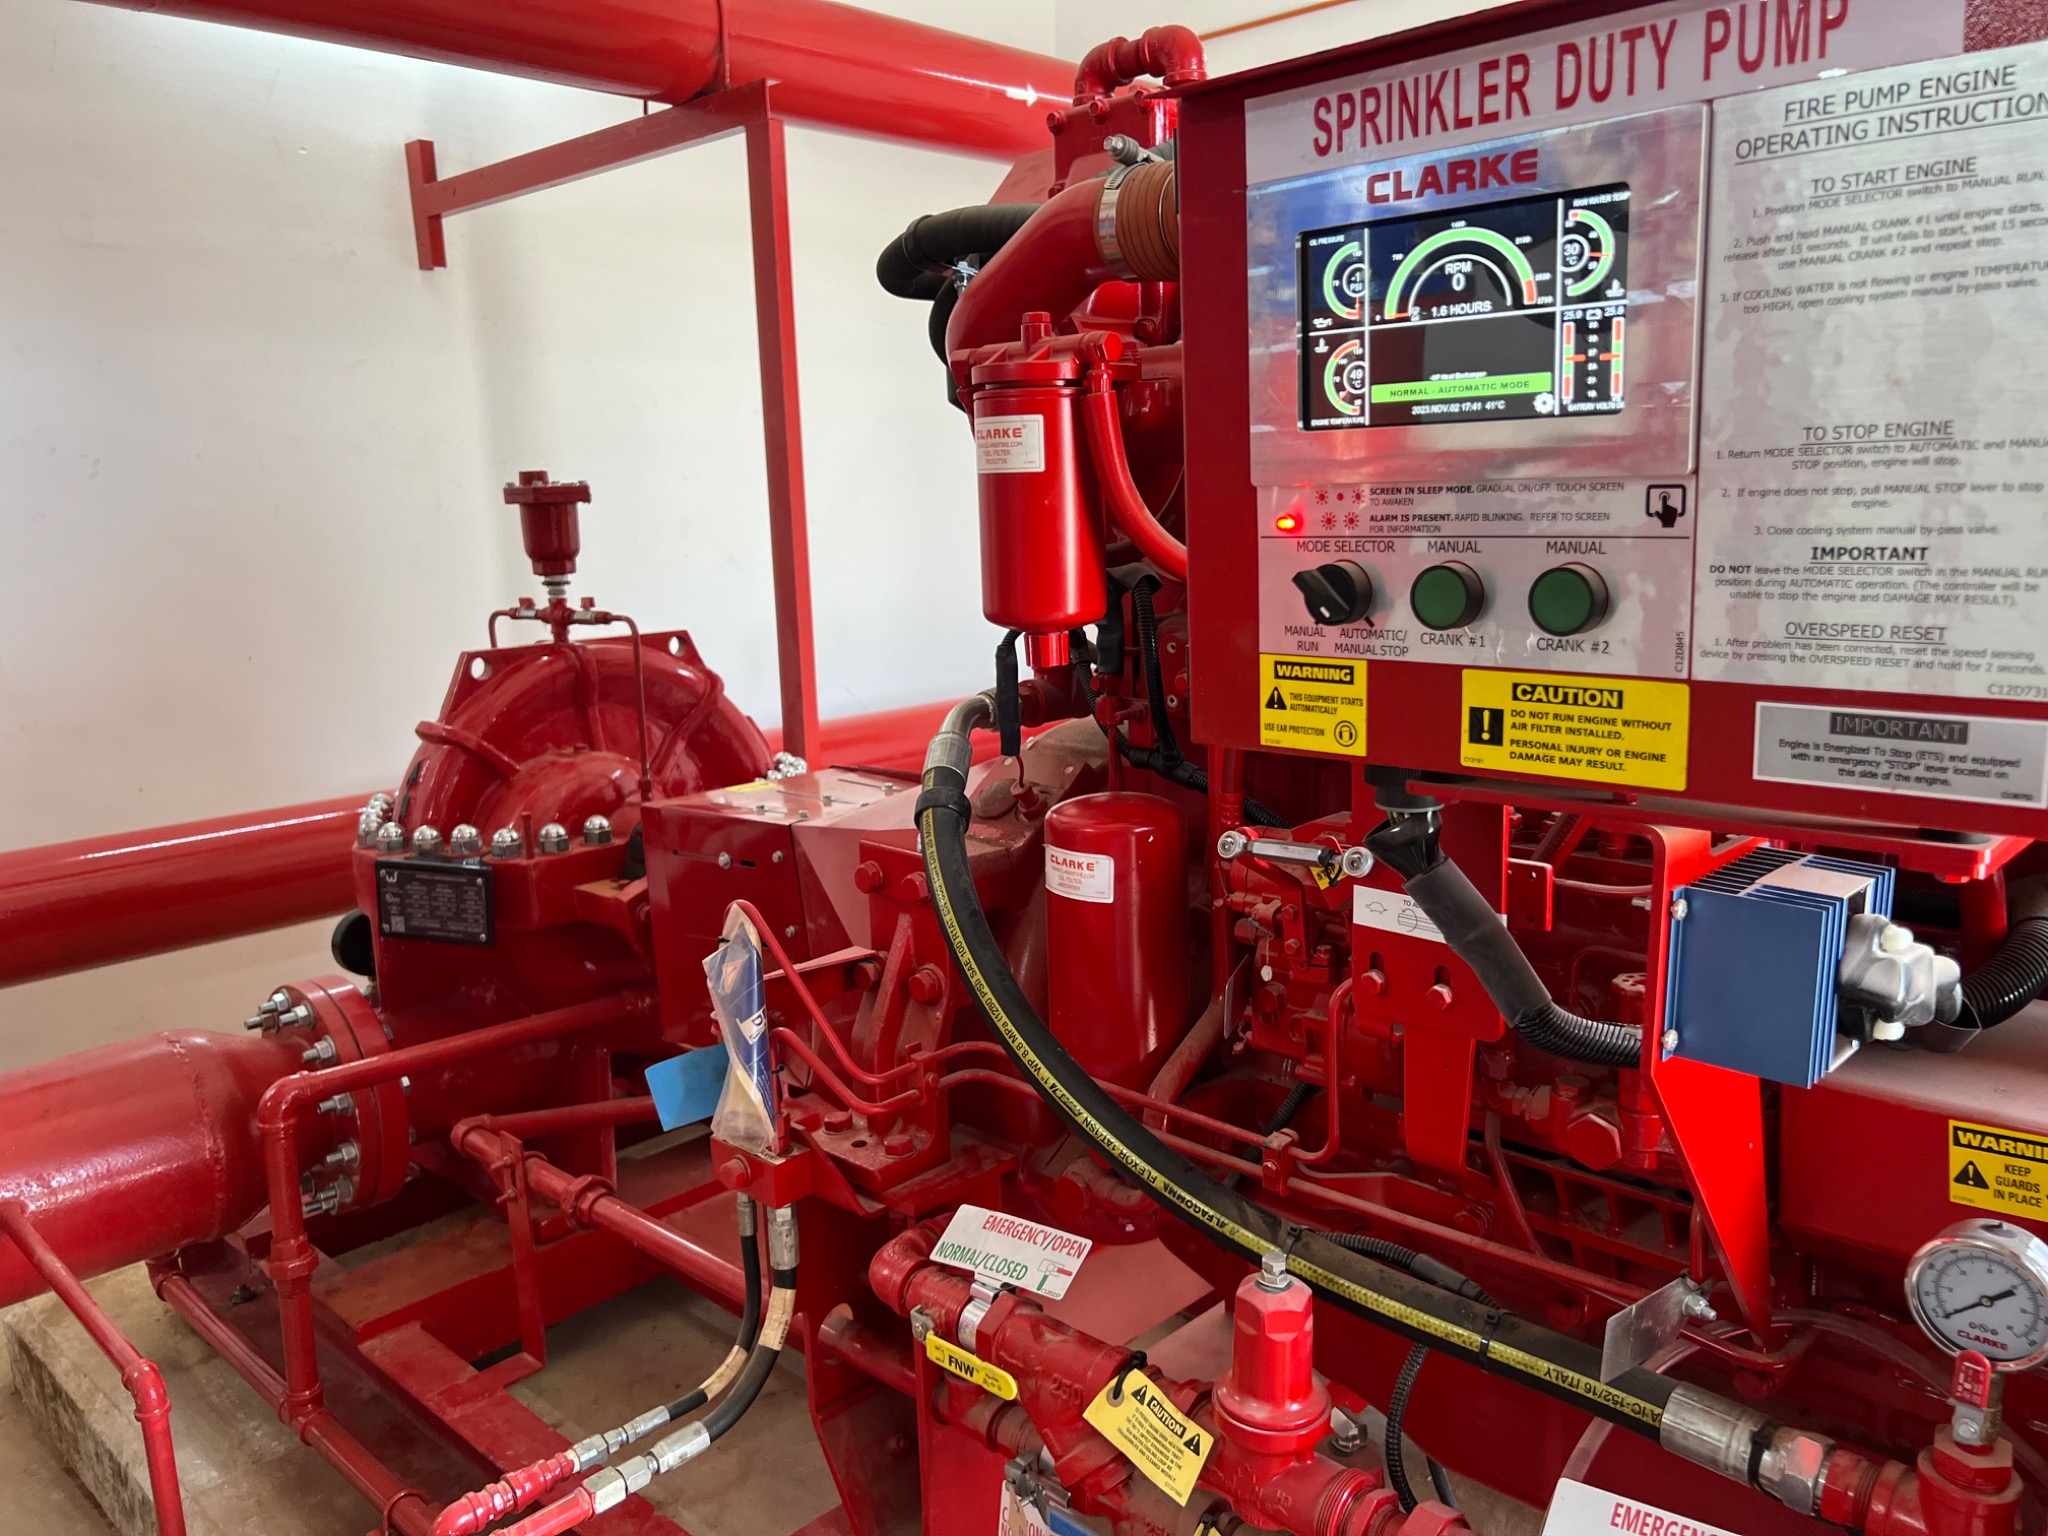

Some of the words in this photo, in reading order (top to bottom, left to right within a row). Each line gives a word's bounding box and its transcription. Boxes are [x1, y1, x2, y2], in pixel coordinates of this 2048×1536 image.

[1312, 52, 1531, 157] SPRINKLER
[1556, 18, 1678, 110] DUTY
[1702, 0, 1850, 81] PUMP
[1784, 94, 1836, 122] FIRE
[1845, 82, 1911, 112] PUMP
[1920, 64, 2016, 99] ENGINE
[1735, 120, 1868, 159] OPERATING
[1366, 149, 1539, 205] CLARKE
[1811, 176, 1835, 194] TO
[1841, 168, 1899, 190] START
[1905, 156, 1978, 181] ENGINE
[1589, 195, 1612, 205] WATER
[1764, 203, 1804, 217] Position
[1808, 198, 1840, 209] MODE
[1564, 243, 1580, 256] 30
[1445, 261, 1472, 275] RPM
[1452, 273, 1465, 291] 0
[1743, 286, 1792, 301] COOLING
[1431, 305, 1447, 318] 1.6
[1450, 301, 1492, 315] HOURS
[1350, 369, 1363, 380] 49
[1390, 388, 1430, 398] NORMAL
[1437, 383, 1497, 395] AUTOMATIC
[1500, 380, 1530, 390] MODE
[1462, 400, 1482, 411] 17:41
[1802, 426, 1827, 441] TO
[1832, 424, 1879, 441] STOP
[1885, 420, 1954, 438] ENGINE
[1728, 450, 1760, 459] Return
[1764, 447, 1794, 457] MODE
[1797, 446, 1852, 457] SELECTOR
[1791, 460, 1820, 470] STOP
[1369, 486, 1402, 496] SCREEN
[1405, 486, 1415, 495] IN
[1417, 486, 1444, 495] SLEEP
[1446, 485, 1475, 495] MODE.
[1475, 484, 1515, 493] GRADUAL
[1556, 482, 1586, 492] TOUCH
[1589, 482, 1624, 491] SCREEN
[1747, 488, 1781, 499] engine
[1784, 487, 1808, 496] does
[1369, 498, 1380, 506] TO
[1381, 497, 1414, 506] AWAKEN
[1369, 514, 1398, 523] ALARM
[1400, 514, 1410, 522] IS
[1412, 513, 1454, 522] PRESENT.
[1454, 513, 1479, 522] RAPID
[1482, 512, 1524, 522] BLINKING.
[1530, 512, 1557, 521] REFER
[1560, 512, 1572, 521] TO
[1575, 512, 1610, 521] SCREEN
[1369, 525, 1384, 533] FOR
[1386, 524, 1441, 533] INFORMATION
[1767, 526, 1793, 535] Close
[1296, 540, 1331, 553] MODE
[1334, 540, 1396, 553] SELECTOR
[1427, 541, 1481, 554] MANUAL
[1546, 541, 1606, 555] MANUAL
[1810, 547, 1929, 561] IMPORTANT
[1709, 565, 1725, 574] DO
[1728, 565, 1751, 574] NOT
[1754, 565, 1780, 575] leave
[1783, 565, 1799, 575] the
[1802, 566, 1834, 576] MODE
[1837, 566, 1893, 577] SELECTOR
[1715, 579, 1751, 588] position
[1755, 579, 1786, 589] during
[1788, 579, 1852, 589] AUTOMATIC
[1730, 590, 1761, 600] unable
[1778, 592, 1798, 601] stop
[1821, 593, 1856, 603] engine
[1284, 626, 1326, 638] MANUAL
[1339, 628, 1407, 642] AUTOMATIC/
[1420, 633, 1463, 646] CRANK
[1468, 636, 1485, 648] #1
[1785, 622, 1884, 639] OVERSPEED
[1890, 626, 1947, 641] RESET
[1297, 641, 1318, 651] RUN
[1334, 643, 1378, 656] MANUAL
[1380, 645, 1409, 657] STOP
[1536, 638, 1584, 653] CRANK
[1590, 641, 1610, 655] #2
[1674, 631, 1685, 673] C12D845
[1725, 638, 1748, 648] After
[1751, 639, 1791, 650] problem
[1700, 649, 1729, 659] device
[1746, 652, 1786, 663] pressing
[1808, 654, 1871, 666] OVERSPEED
[1874, 657, 1910, 669] RESET
[1277, 664, 1351, 681] WARNING
[1289, 693, 1302, 701] THIS
[1304, 694, 1339, 705] EQUIPMENT
[1340, 697, 1364, 707] STARTS
[1516, 685, 1618, 707] CAUTION
[1289, 703, 1337, 715] AUTOMATICALLY
[1511, 709, 1526, 718] DO
[1529, 711, 1549, 720] NOT
[1553, 713, 1574, 723] RUN
[1577, 715, 1618, 727] ENGINE
[1621, 719, 1672, 731] WITHOUT
[1835, 716, 1964, 741] IMPORTANT
[1264, 723, 1274, 731] USE
[1277, 724, 1287, 732] EAR
[1288, 725, 1325, 736] PROTECTION
[1510, 722, 1528, 731] AIR
[1531, 724, 1562, 734] FILTER
[1565, 726, 1625, 741] INSTALLED.
[1510, 739, 1562, 752] PERSONAL
[1565, 744, 1602, 755] INJURY
[1606, 748, 1621, 758] OR
[1624, 750, 1666, 762] ENGINE
[1779, 739, 1810, 751] Engine
[1510, 752, 1556, 764] DAMAGE
[1558, 756, 1583, 767] MAY
[1586, 759, 1626, 771] RESULT.
[1050, 854, 1094, 872] CLARKE
[957, 941, 966, 957] 100
[963, 957, 977, 979] SAE
[974, 979, 988, 998] PSI)
[985, 998, 1003, 1023] (1280
[1002, 1021, 1018, 1043] MPa
[1016, 1042, 1029, 1058] 8.8
[1027, 1058, 1041, 1076] WP
[1082, 1116, 1120, 1149] 1AT/1SN
[1119, 1149, 1158, 1184] FLEXOR
[2004, 1164, 2031, 1177] KEEP
[1995, 1175, 2040, 1194] GUARDS
[1162, 1181, 1229, 1231] ALFAGOMMA
[1993, 1188, 2005, 1200] IN
[2008, 1192, 2042, 1208] PLACE
[982, 1215, 1087, 1259] EMERGENCY/OPEN
[935, 1241, 1028, 1281] NORMAL/CLOSED
[1957, 1330, 2009, 1351] CLARKE
[949, 1354, 974, 1378] FNW
[1544, 1366, 1579, 1390] ITALY
[1584, 1382, 1645, 1416] IC-152/16
[1150, 1400, 1183, 1437] CAUTION
